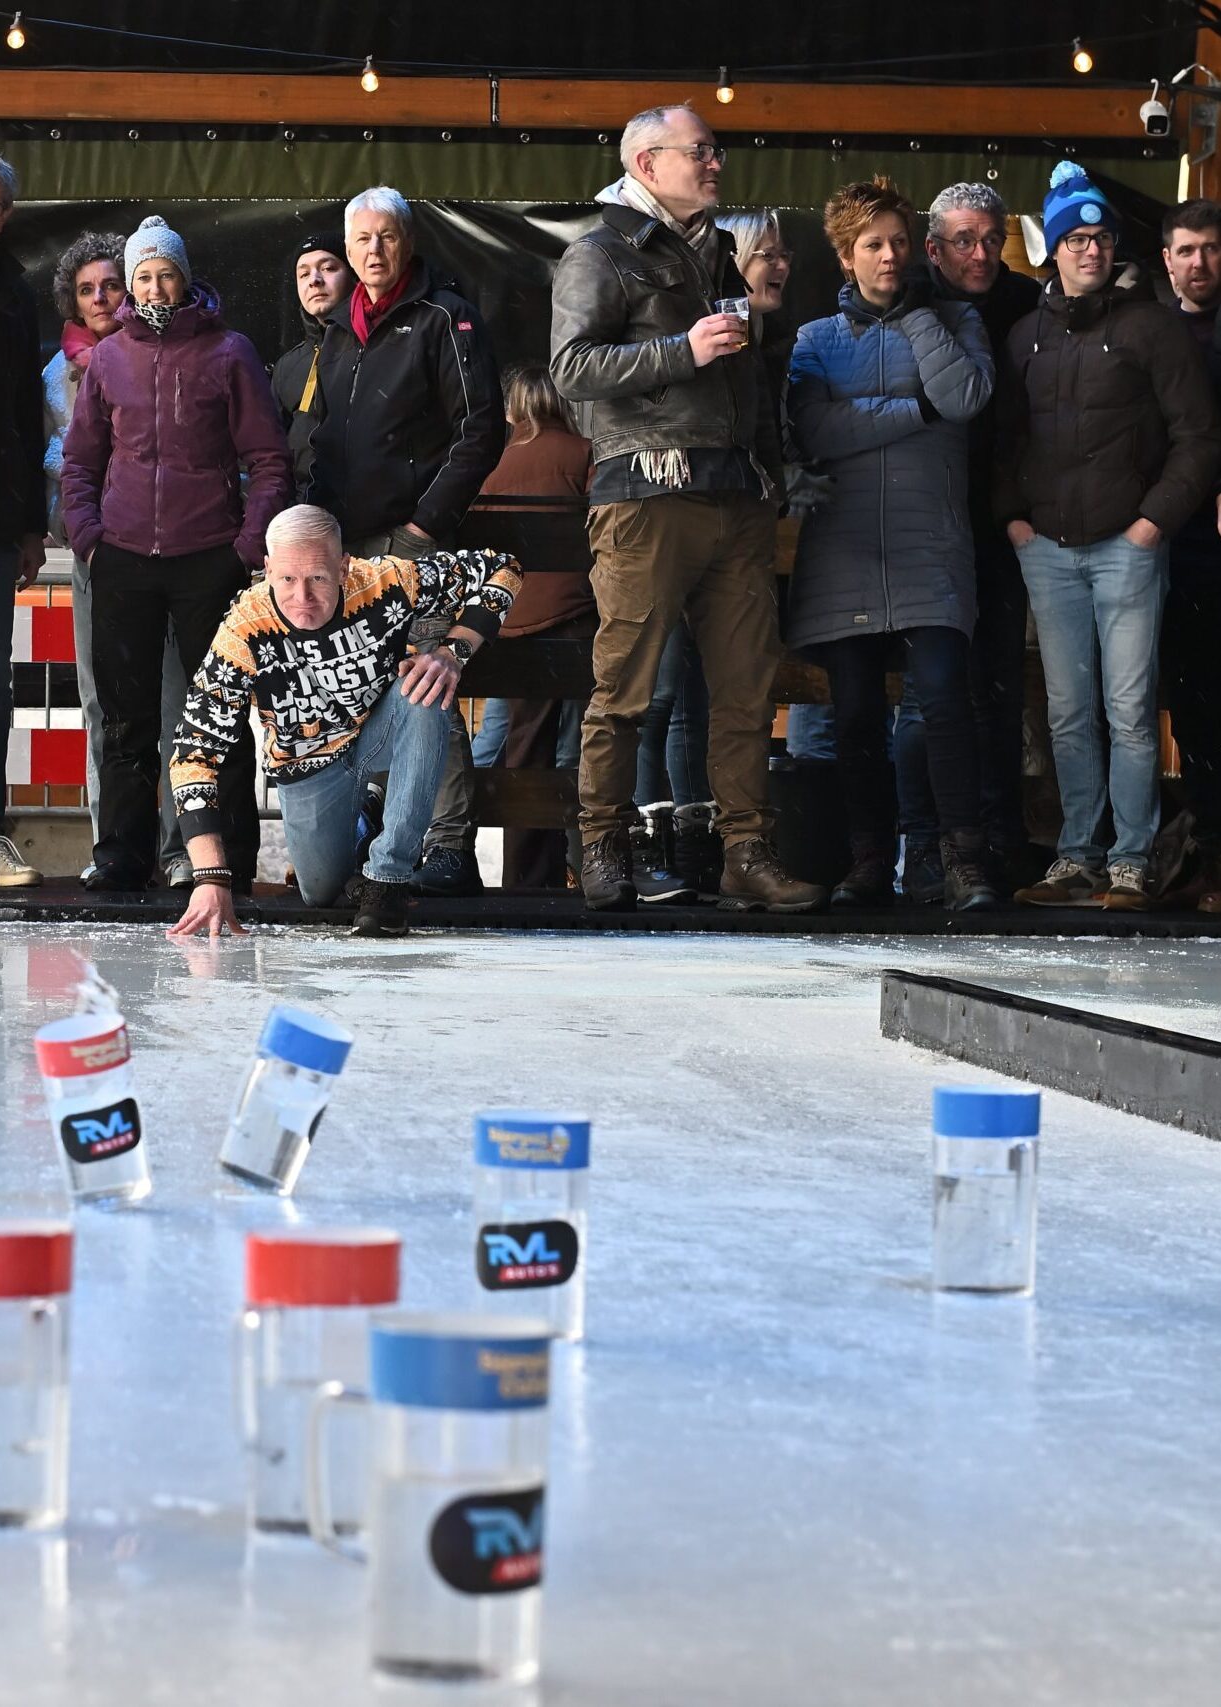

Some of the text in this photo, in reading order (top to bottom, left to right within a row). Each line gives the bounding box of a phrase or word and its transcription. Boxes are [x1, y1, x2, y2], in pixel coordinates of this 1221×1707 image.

[329, 618, 376, 657] THE
[71, 1111, 133, 1145] RVL
[483, 1231, 561, 1266] RVL
